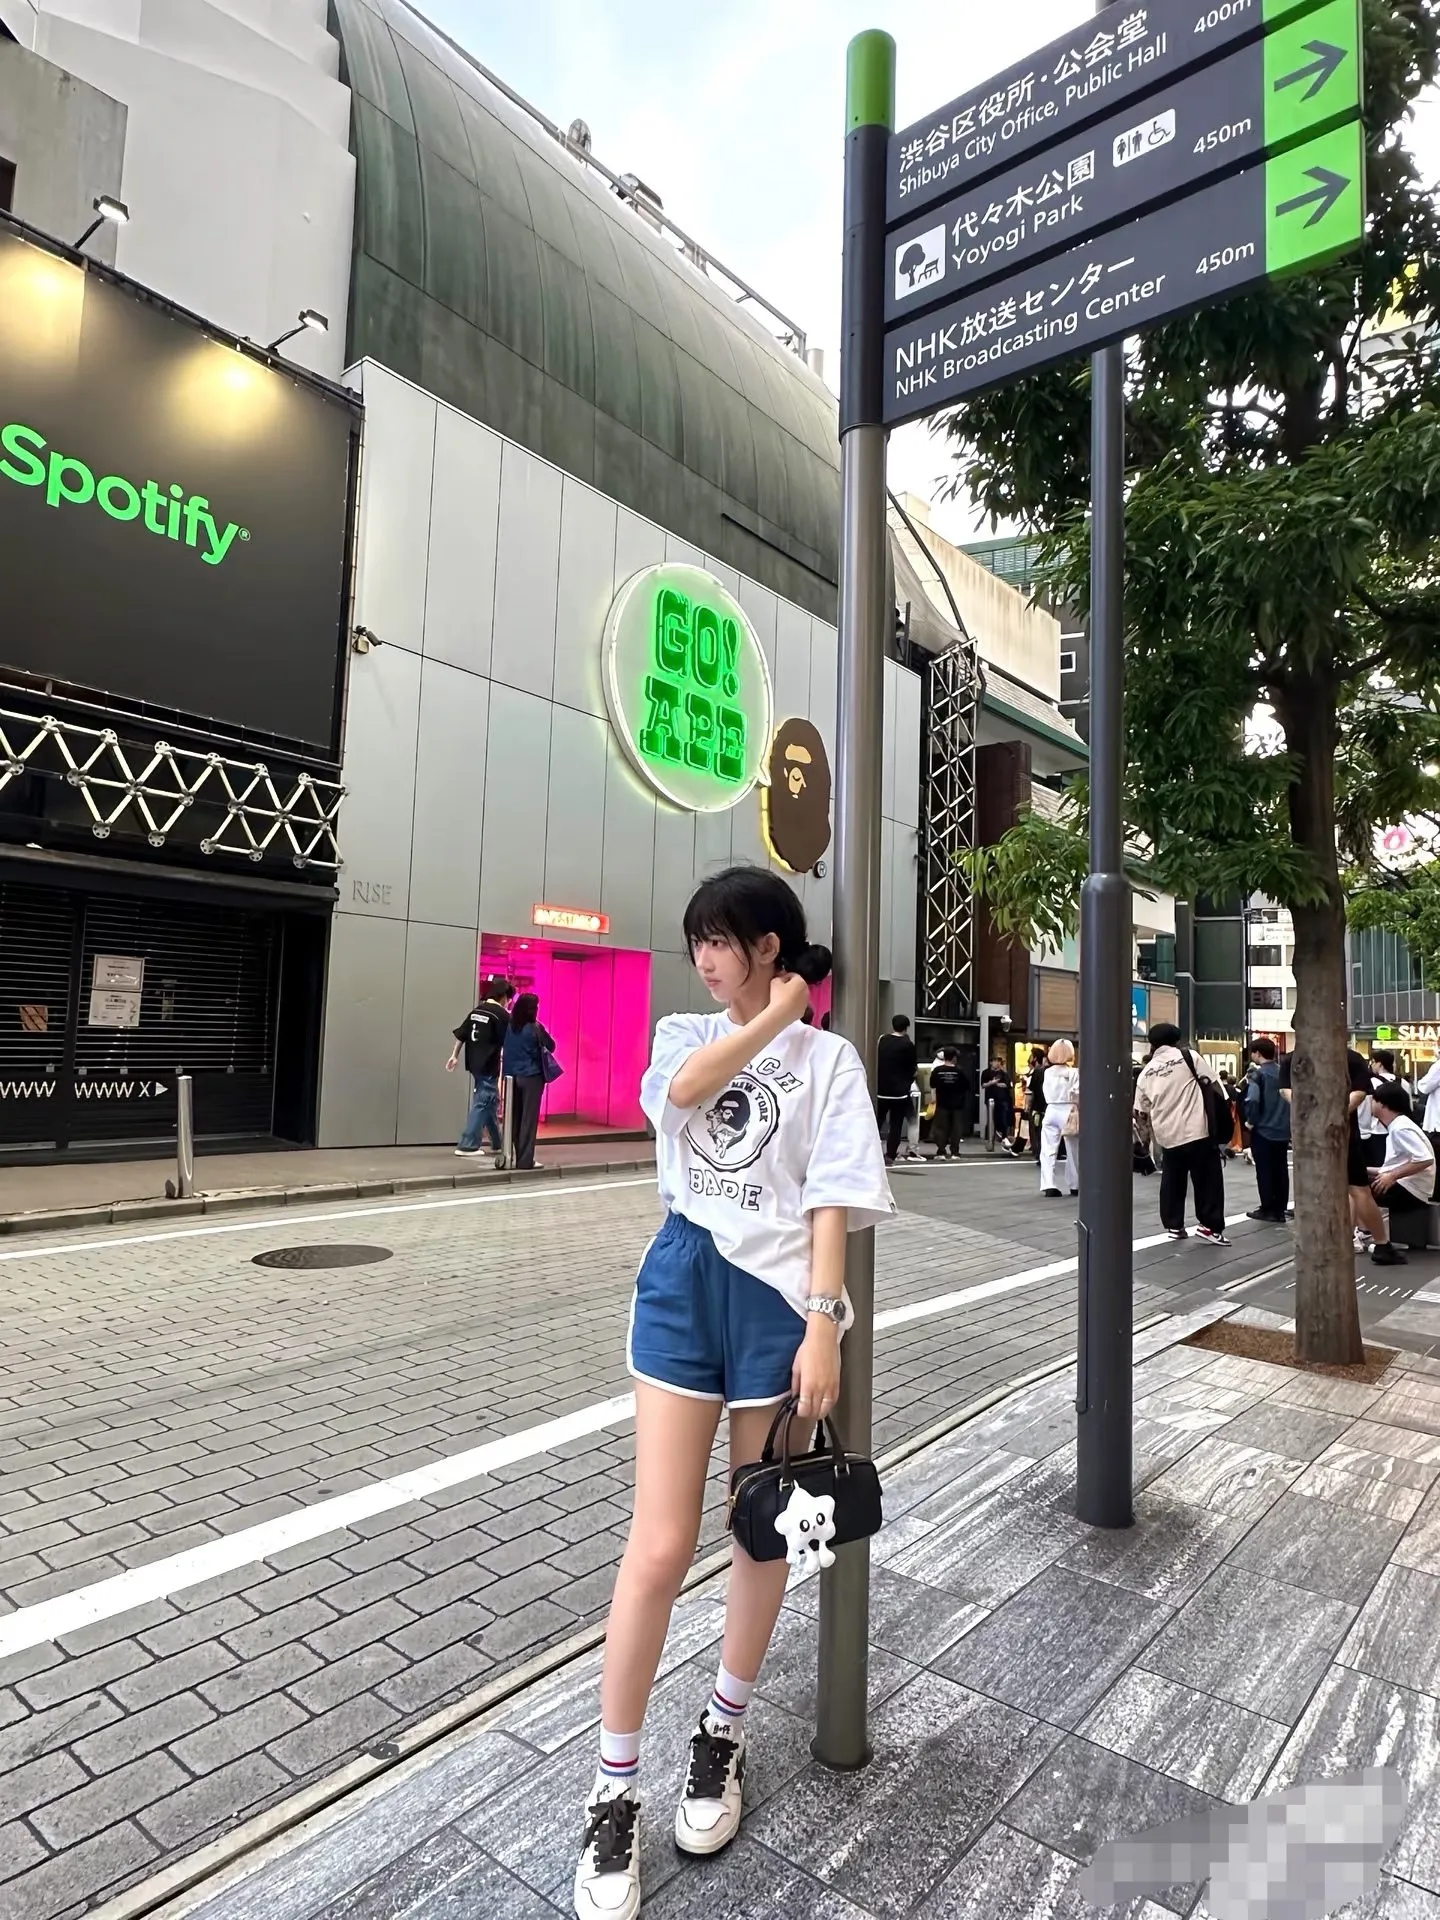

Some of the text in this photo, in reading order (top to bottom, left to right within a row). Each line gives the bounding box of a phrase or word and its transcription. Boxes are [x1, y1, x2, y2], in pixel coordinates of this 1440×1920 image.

[1193, 0, 1251, 33] 400m
[899, 9, 1149, 174] 渋谷区役所・公会堂
[899, 31, 1167, 198] Shibuya City Office, Public Hall
[1193, 118, 1251, 153] 450m
[952, 150, 1095, 247] 代々木公園
[952, 194, 1084, 270] Yoyogi Park
[1195, 242, 1255, 274] 450m
[895, 256, 1136, 374] NHK放送センター
[895, 274, 1166, 399] NHK Broadcasting Center
[656, 588, 742, 698] GO!
[639, 675, 747, 782] APE
[352, 879, 393, 905] RISE
[1398, 1024, 1440, 1041] SHA
[754, 1092, 768, 1123] YORK
